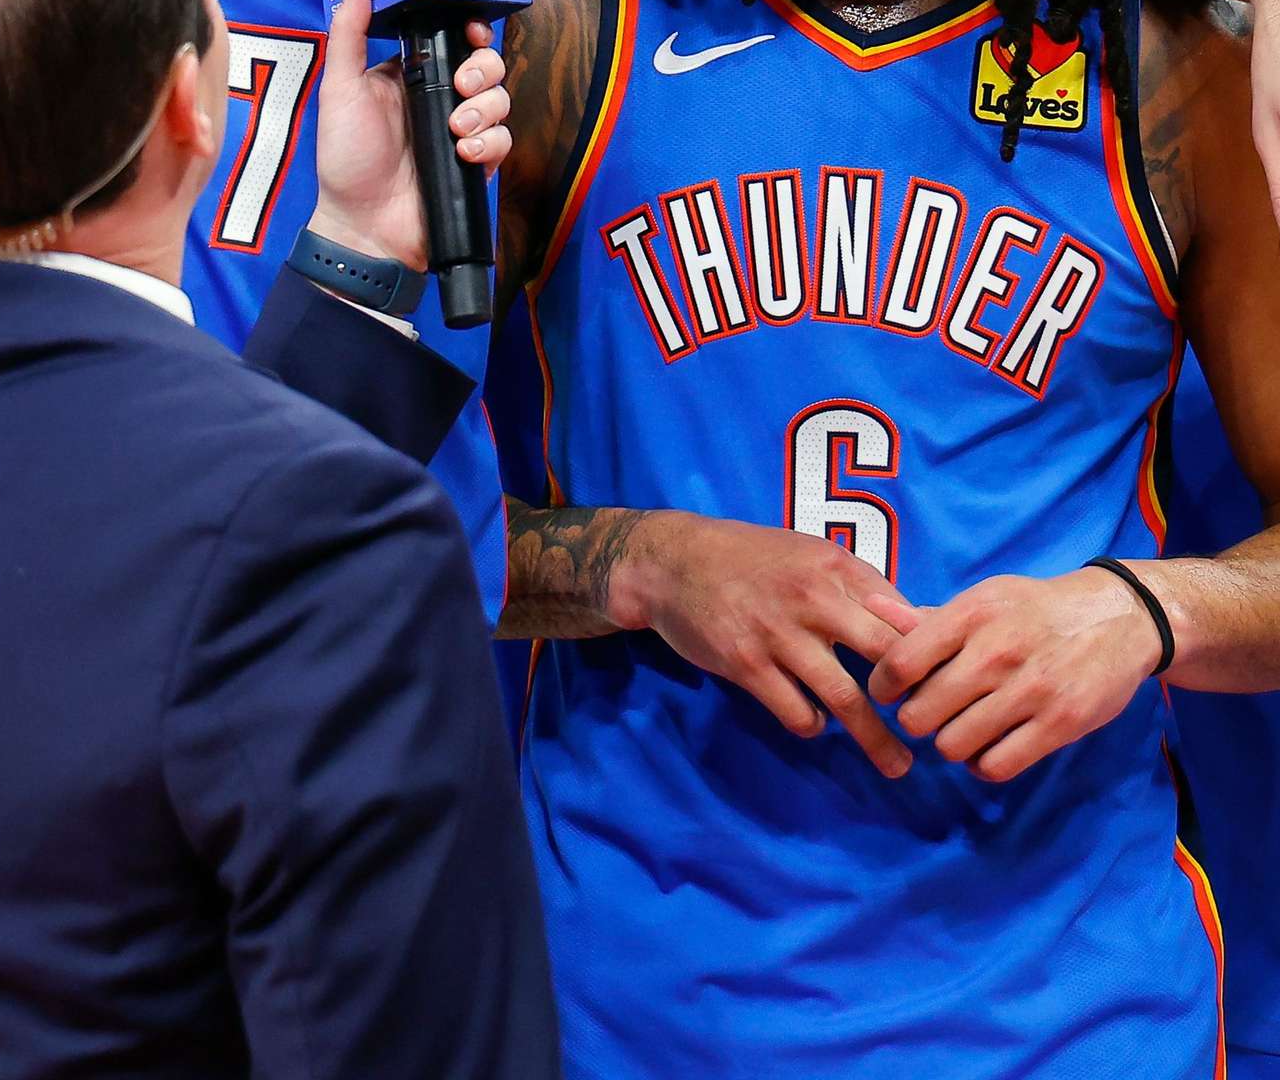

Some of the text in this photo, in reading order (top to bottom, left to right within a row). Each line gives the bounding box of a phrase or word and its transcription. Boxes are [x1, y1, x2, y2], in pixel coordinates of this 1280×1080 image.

[209, 22, 328, 255] 7
[600, 166, 1106, 402] THUNDER
[783, 397, 901, 586] 6
